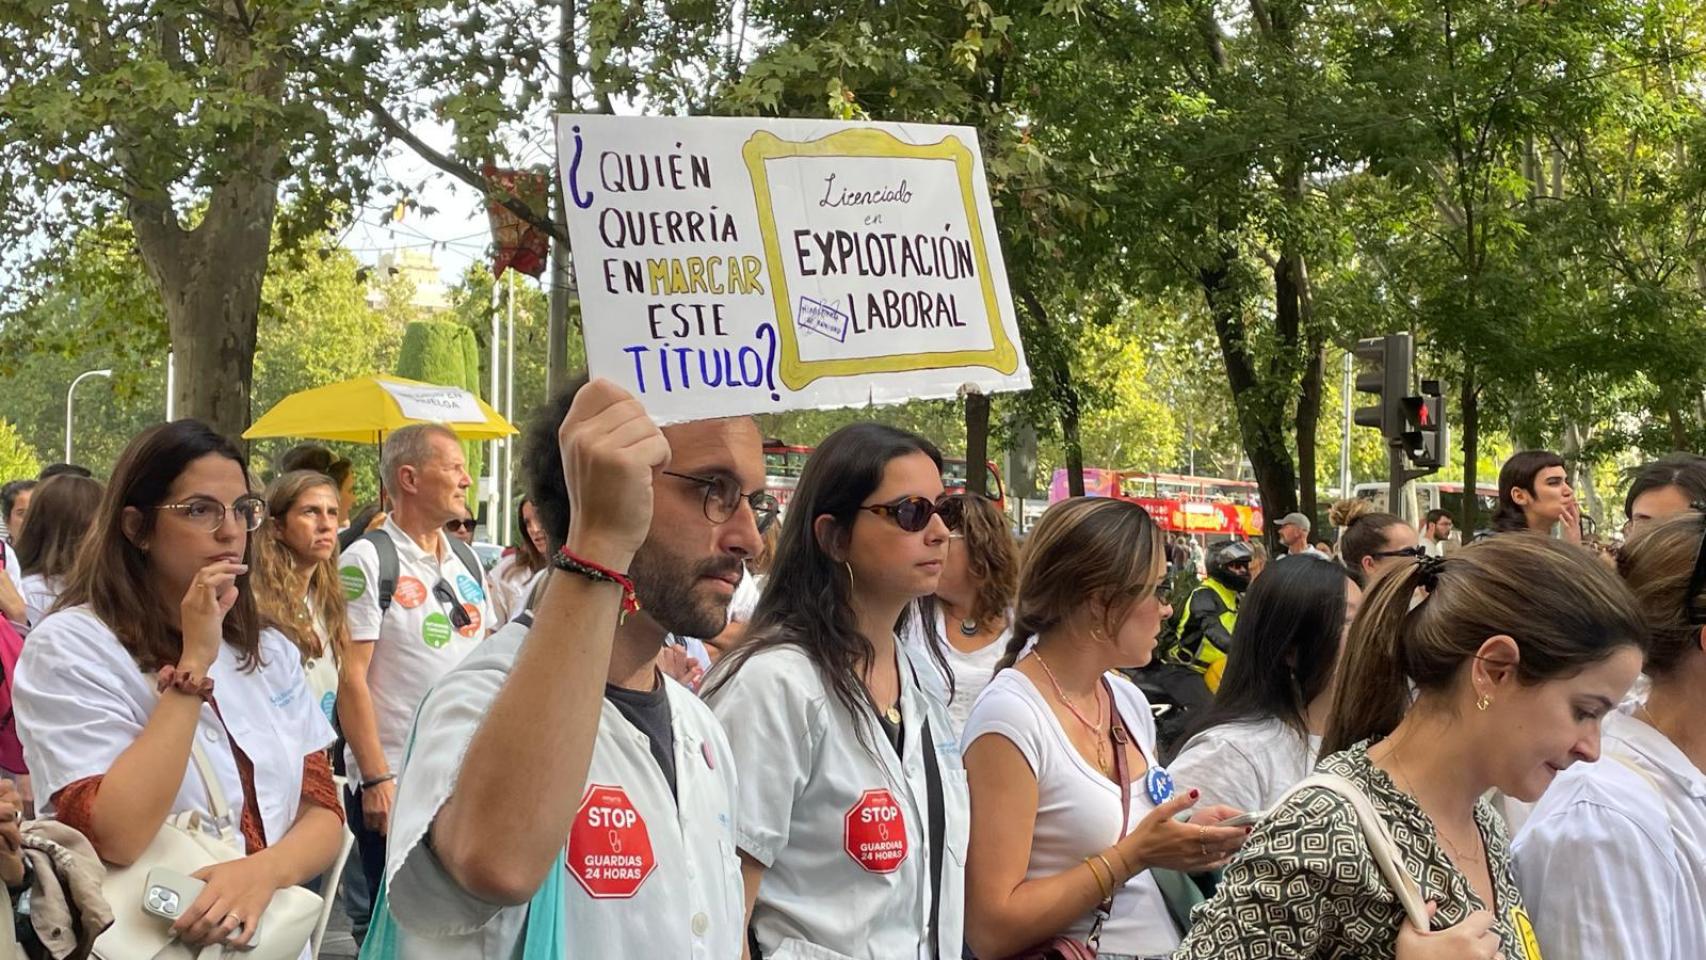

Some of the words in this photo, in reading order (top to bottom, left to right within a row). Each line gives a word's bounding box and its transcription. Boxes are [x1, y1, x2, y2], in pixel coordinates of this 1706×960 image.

[819, 173, 912, 207] Licenciado
[599, 205, 738, 248] QUERRÍA
[864, 213, 883, 226] en
[793, 223, 974, 280] EXPLOTACIÓN
[648, 303, 729, 339] ESTE
[848, 289, 966, 334] LABORAL
[623, 322, 780, 402] TÍTULO?
[588, 806, 637, 828] STOP
[861, 806, 898, 823] STOP
[860, 840, 903, 852] GUARDIAS
[861, 851, 873, 861] 24
[875, 849, 902, 860] HORAS
[584, 855, 642, 867] GUARDIAS
[585, 868, 601, 879] 24
[603, 868, 641, 880] HORAS
